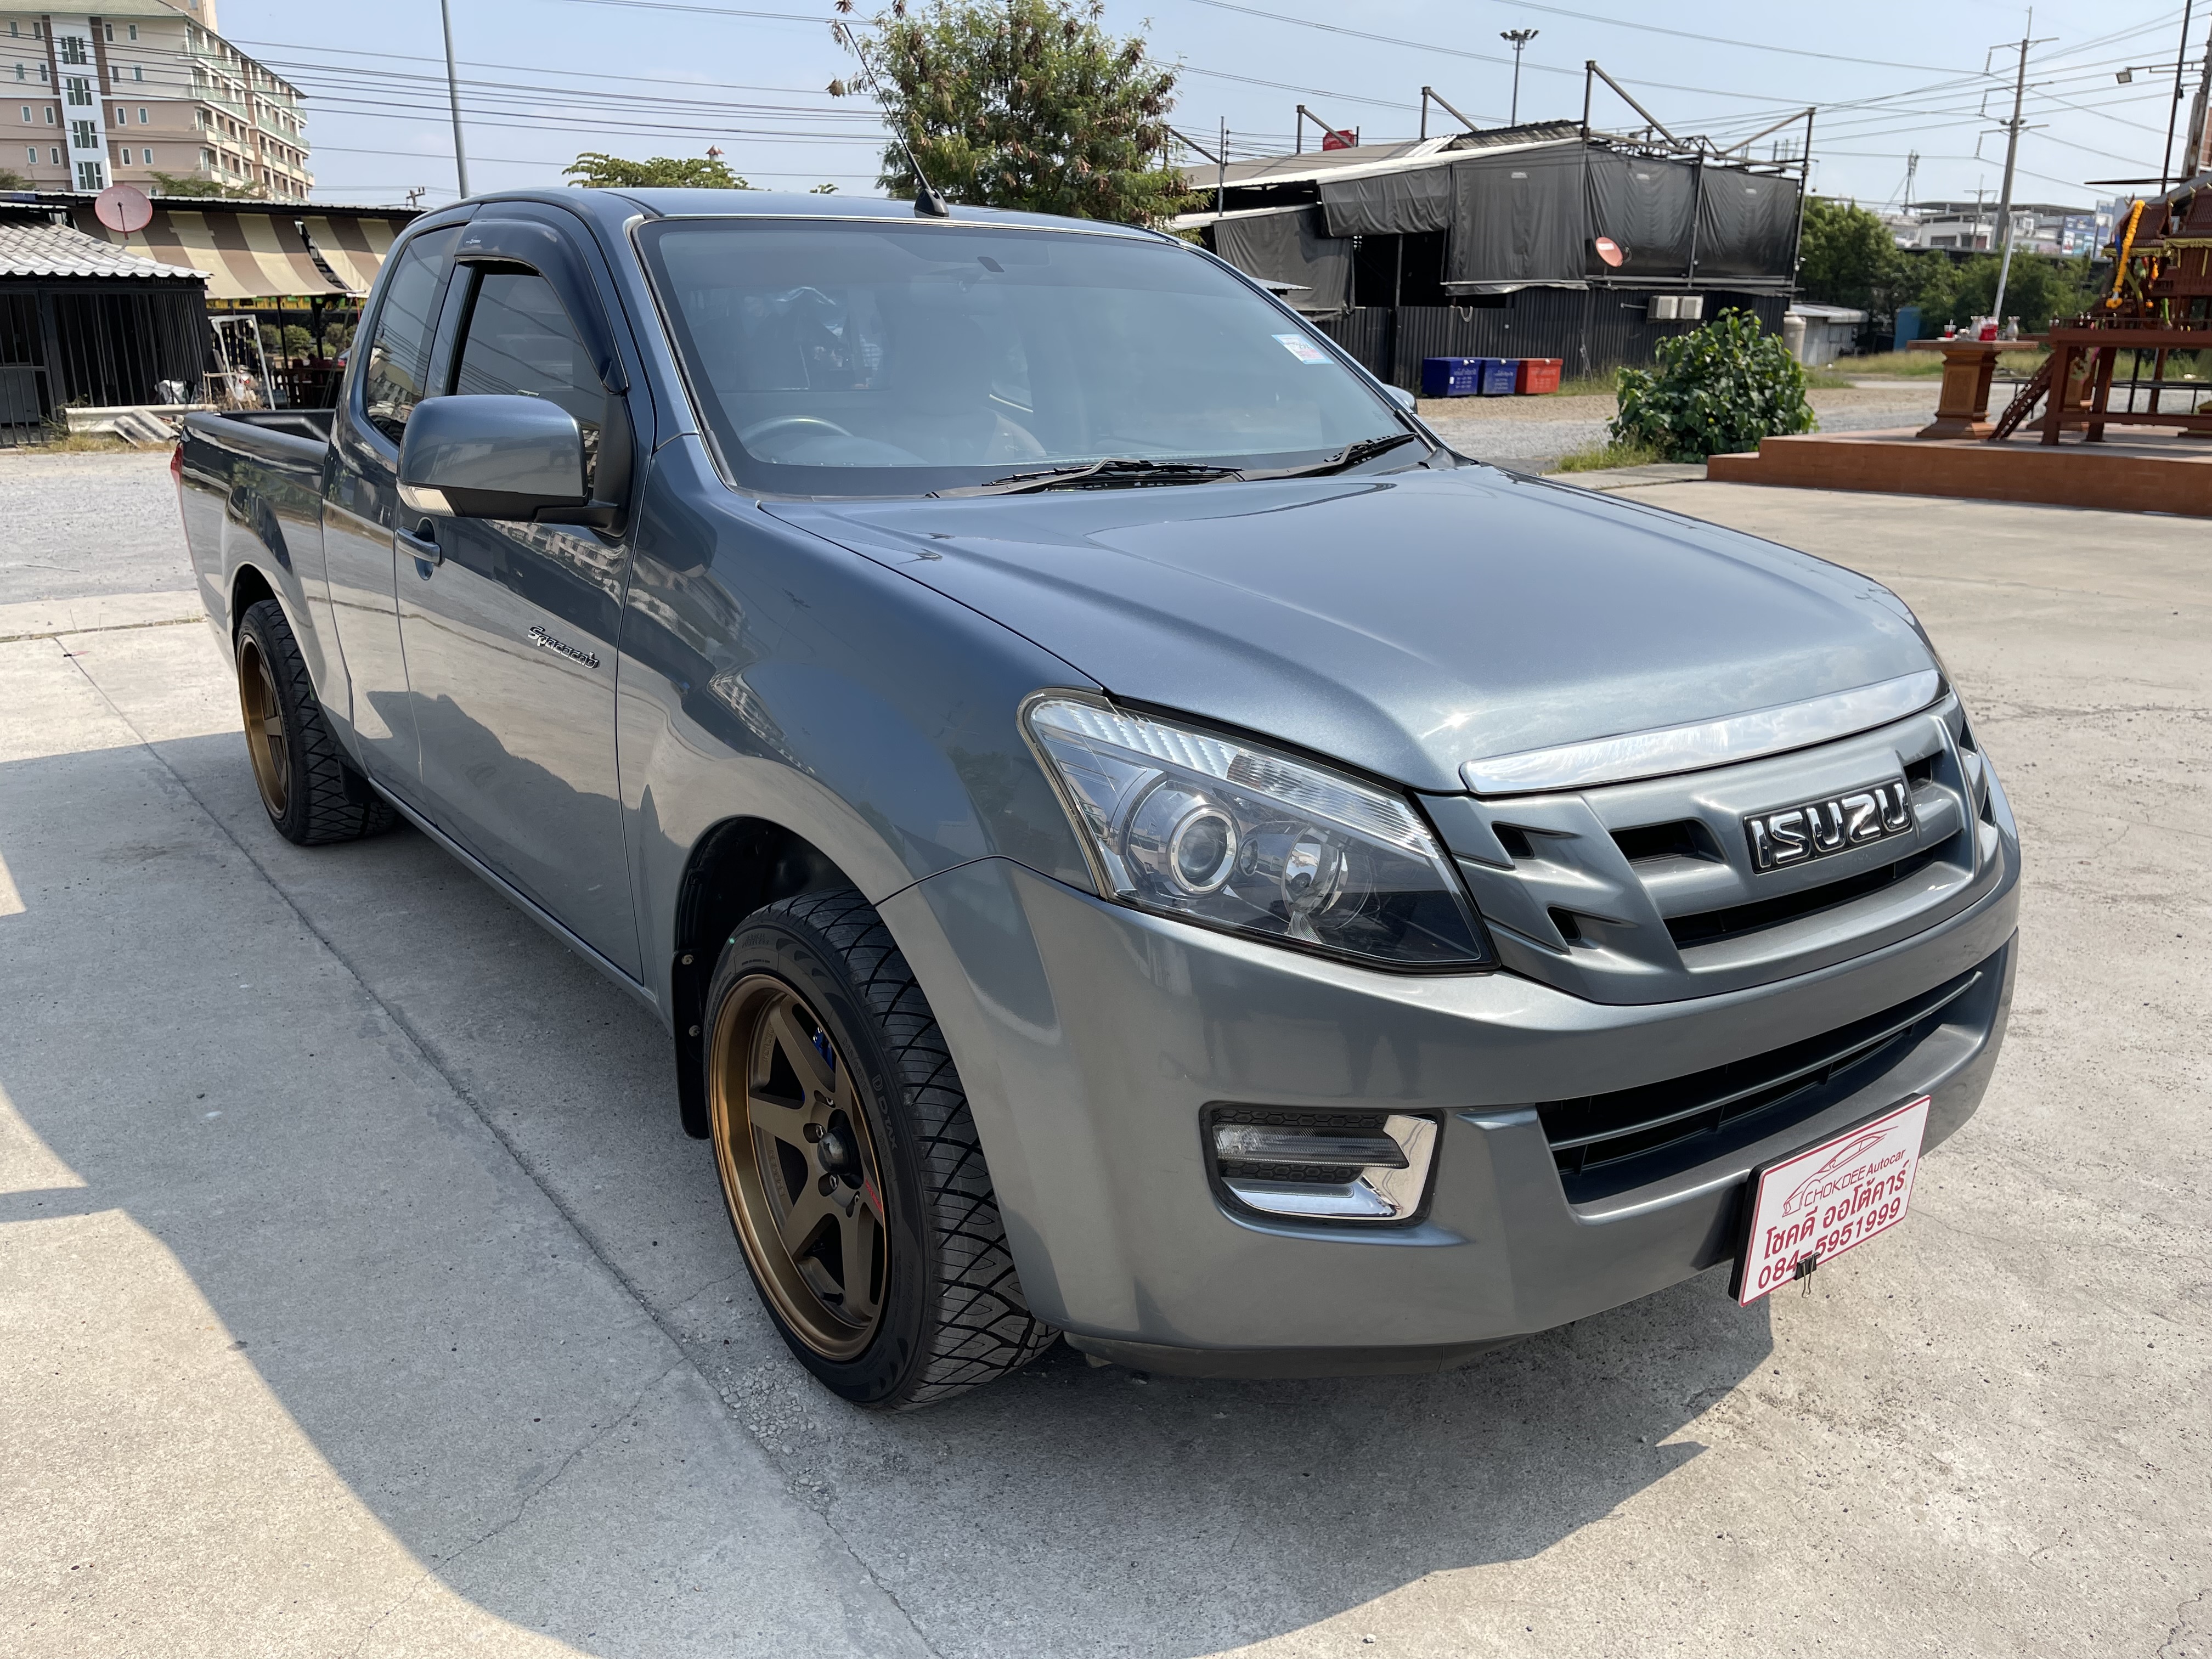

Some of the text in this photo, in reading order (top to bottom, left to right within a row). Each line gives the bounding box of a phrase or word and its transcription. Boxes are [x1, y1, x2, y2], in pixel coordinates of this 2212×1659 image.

[527, 625, 600, 669] Spacecab
[1751, 782, 1911, 868] ISUZU
[1764, 1159, 1910, 1260] โชคดี ออโต้คาร์
[1804, 1148, 1906, 1207] CHOKDEE Autocar
[1758, 1197, 1901, 1289] 084-5951999
